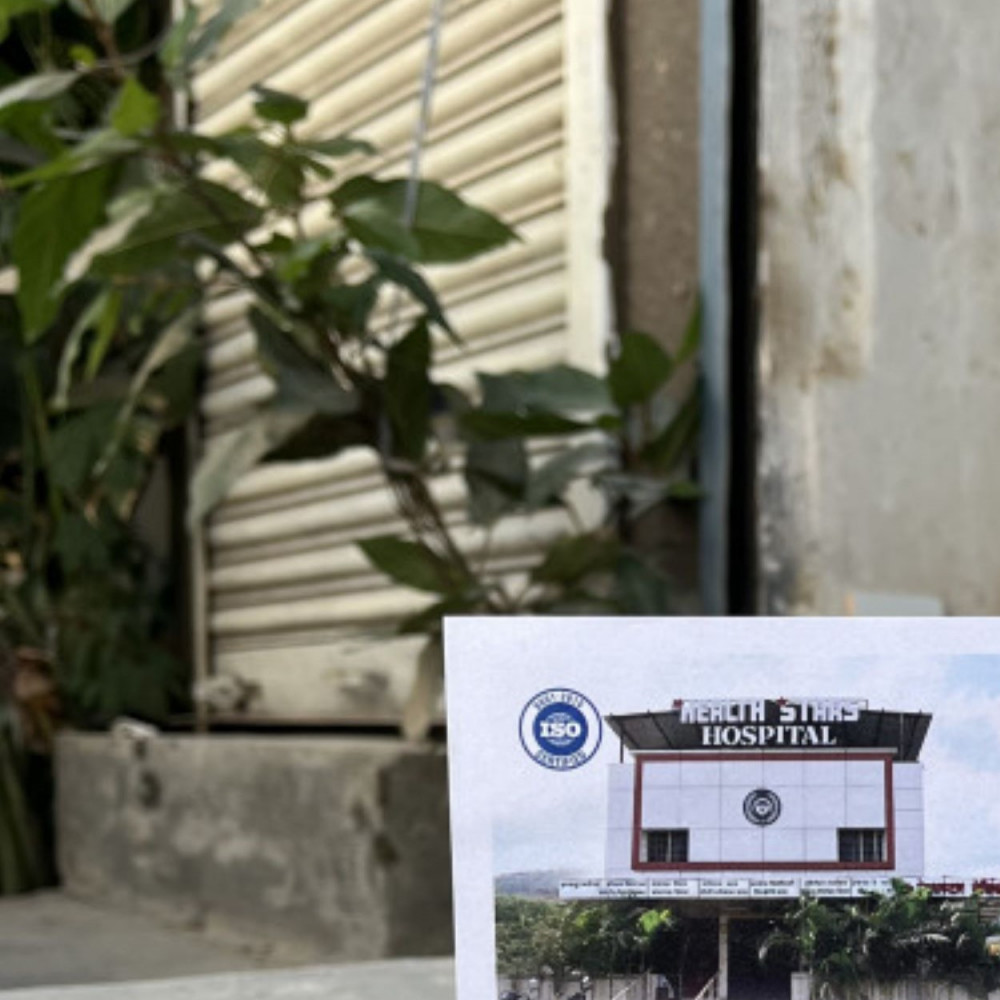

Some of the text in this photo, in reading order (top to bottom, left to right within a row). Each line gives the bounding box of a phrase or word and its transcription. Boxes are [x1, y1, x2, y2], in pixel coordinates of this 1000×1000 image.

[681, 698, 861, 725] HEALTH STARS
[539, 722, 582, 738] ISO
[701, 724, 838, 747] HOSPITAL
